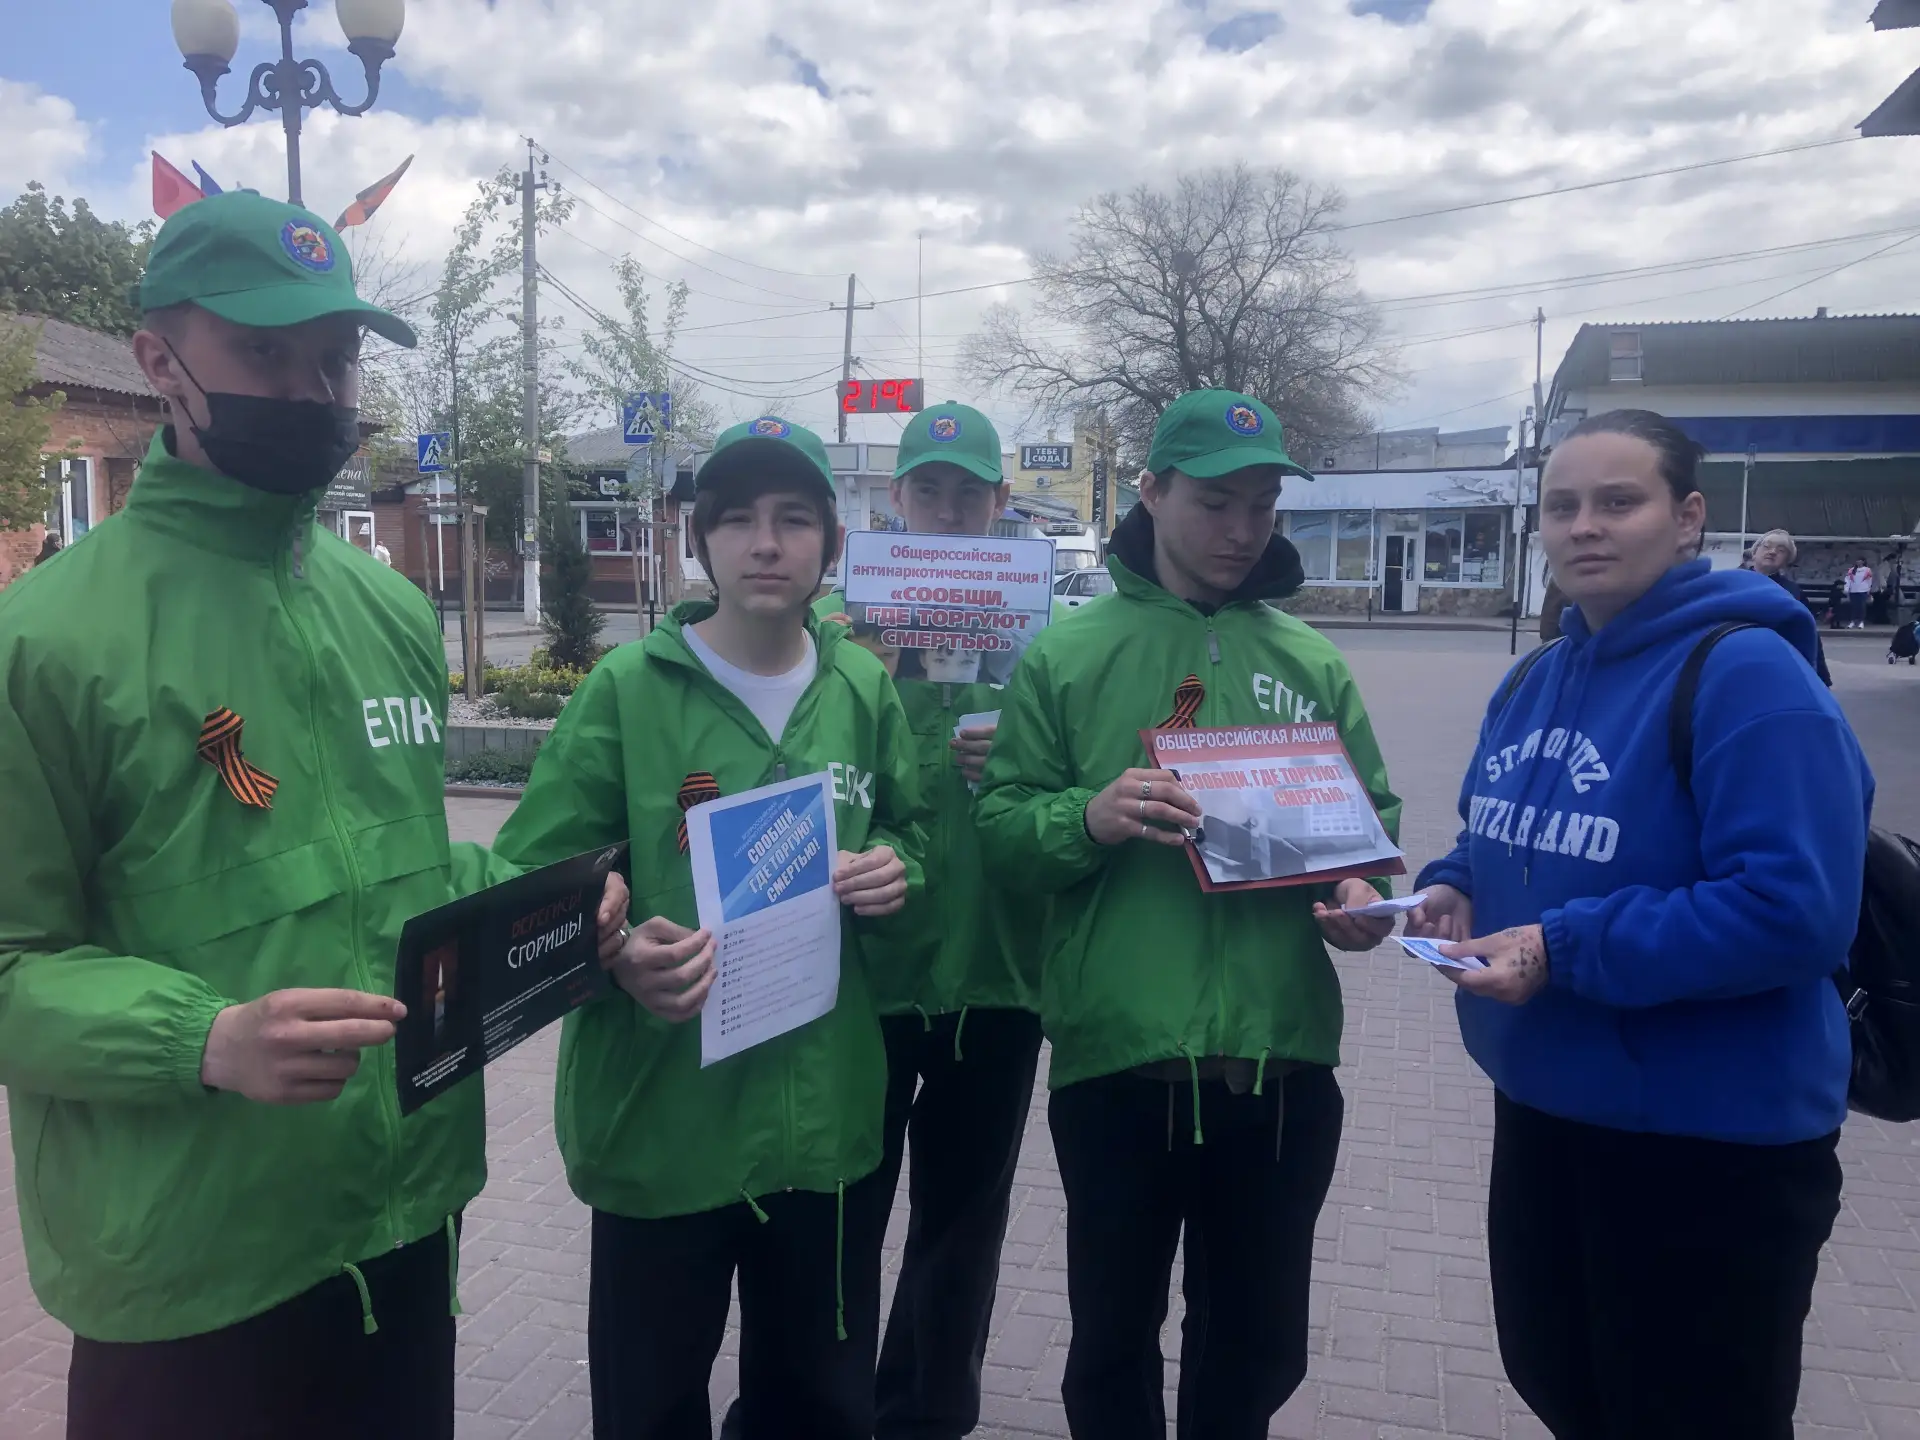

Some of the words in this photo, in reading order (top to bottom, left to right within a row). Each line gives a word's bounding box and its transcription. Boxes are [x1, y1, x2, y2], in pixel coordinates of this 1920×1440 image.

[1032, 454, 1060, 463] СЮДА
[1035, 447, 1058, 455] ТЕБЕ
[890, 545, 1012, 563] Общероссийская
[852, 564, 993, 581] антинаркотическая
[996, 571, 1039, 584] акция
[890, 586, 1009, 608] «СООБЩИ,
[865, 606, 911, 627] ГДЕ
[917, 607, 1031, 630] ТОРГУЮТ
[881, 629, 1013, 651] СМЕРТЬЮ»
[1252, 672, 1318, 724] ЕПК
[362, 696, 441, 748] ЕПК
[1155, 727, 1288, 752] ОБЩЕРОССИЙСКАЯ
[1291, 726, 1336, 745] АКЦИЯ
[828, 761, 873, 809] ЕПК
[1250, 768, 1282, 788] ГДЕ
[1278, 764, 1345, 785] ТОРГУЮТ
[747, 807, 799, 866] СООБЩИ,
[748, 863, 774, 894] ГДЕ
[769, 813, 816, 871] ТОРГУЮТ
[766, 836, 822, 903] СМЕРТЬЮ!
[507, 912, 583, 969] СГОРИШЬ!
